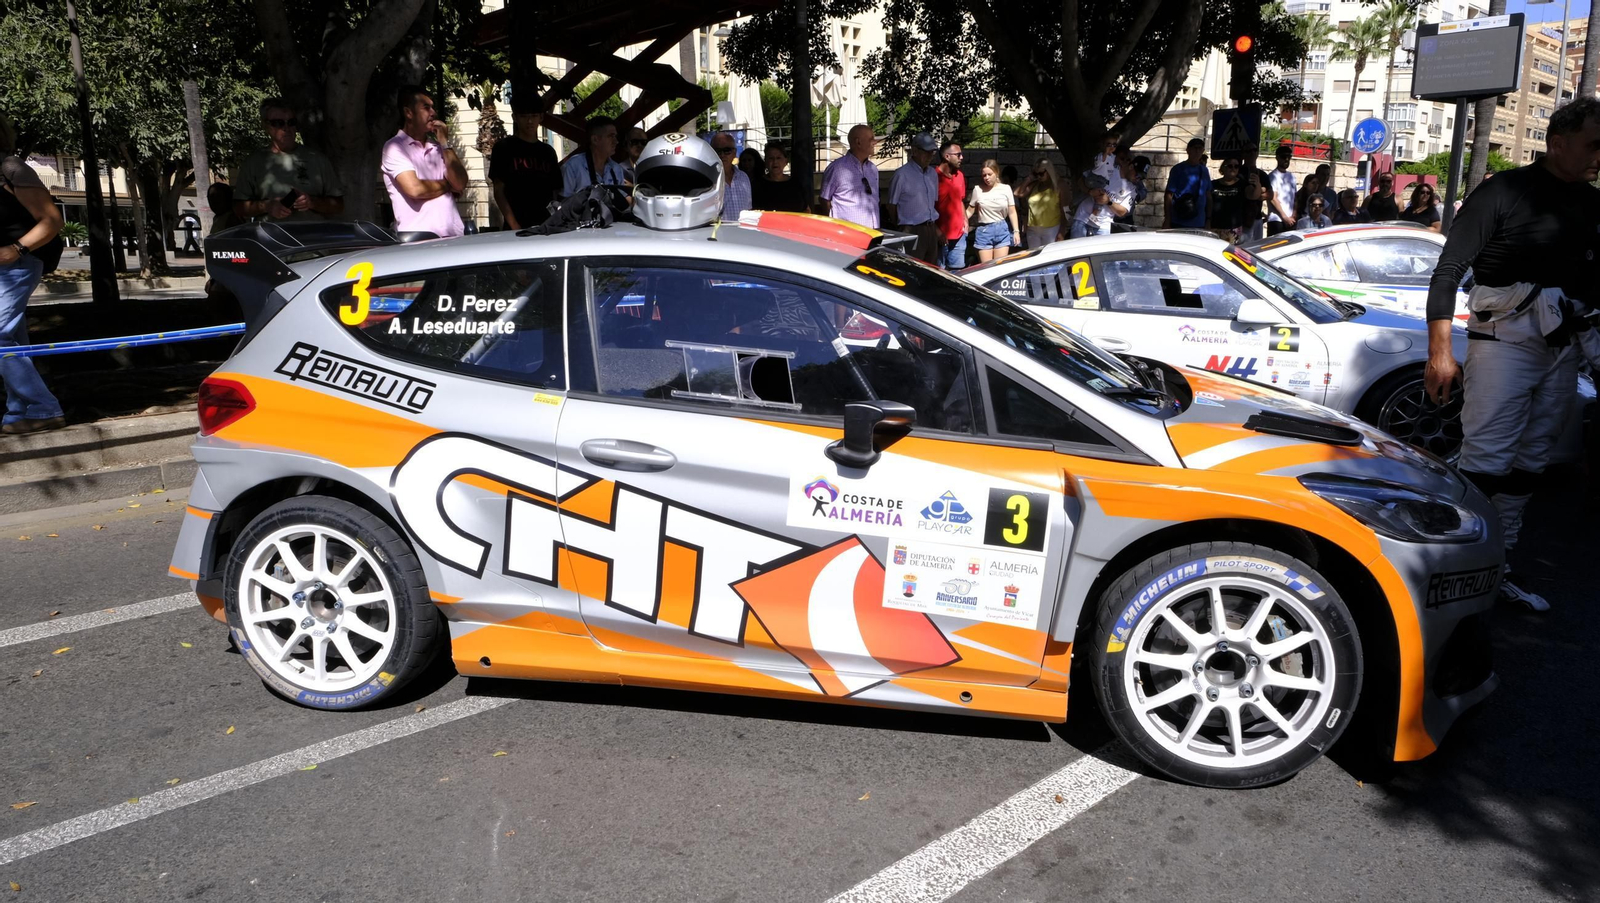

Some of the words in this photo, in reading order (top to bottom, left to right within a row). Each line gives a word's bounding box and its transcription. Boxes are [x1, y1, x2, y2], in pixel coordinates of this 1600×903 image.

[1439, 39, 1459, 47] ZONA
[513, 157, 552, 173] POLO
[212, 251, 246, 259] PLEMAR
[1222, 251, 1258, 274] 2
[856, 265, 906, 287] 3
[1071, 261, 1096, 297] 2
[339, 261, 374, 326] 3
[437, 295, 456, 312] D.
[462, 294, 518, 312] Perez
[388, 317, 407, 335] A.
[412, 317, 516, 335] Leseduarte
[1277, 328, 1291, 350] 2
[843, 494, 884, 507] COSTA
[887, 499, 903, 510] DE
[828, 506, 903, 527] ALMERÍA
[1002, 494, 1030, 544] 3
[918, 520, 973, 535] PLAYCAR
[910, 553, 955, 564] DIPUTACIÓN
[921, 561, 953, 571] ALMERÍA
[989, 570, 1014, 578] CIUDAD
[990, 561, 1039, 575] ALMERÍA
[1243, 561, 1277, 574] SPORT
[936, 592, 978, 606] ANIVERSARIO
[1123, 563, 1198, 625] MICHELIN
[304, 688, 372, 704] MICHELIN
